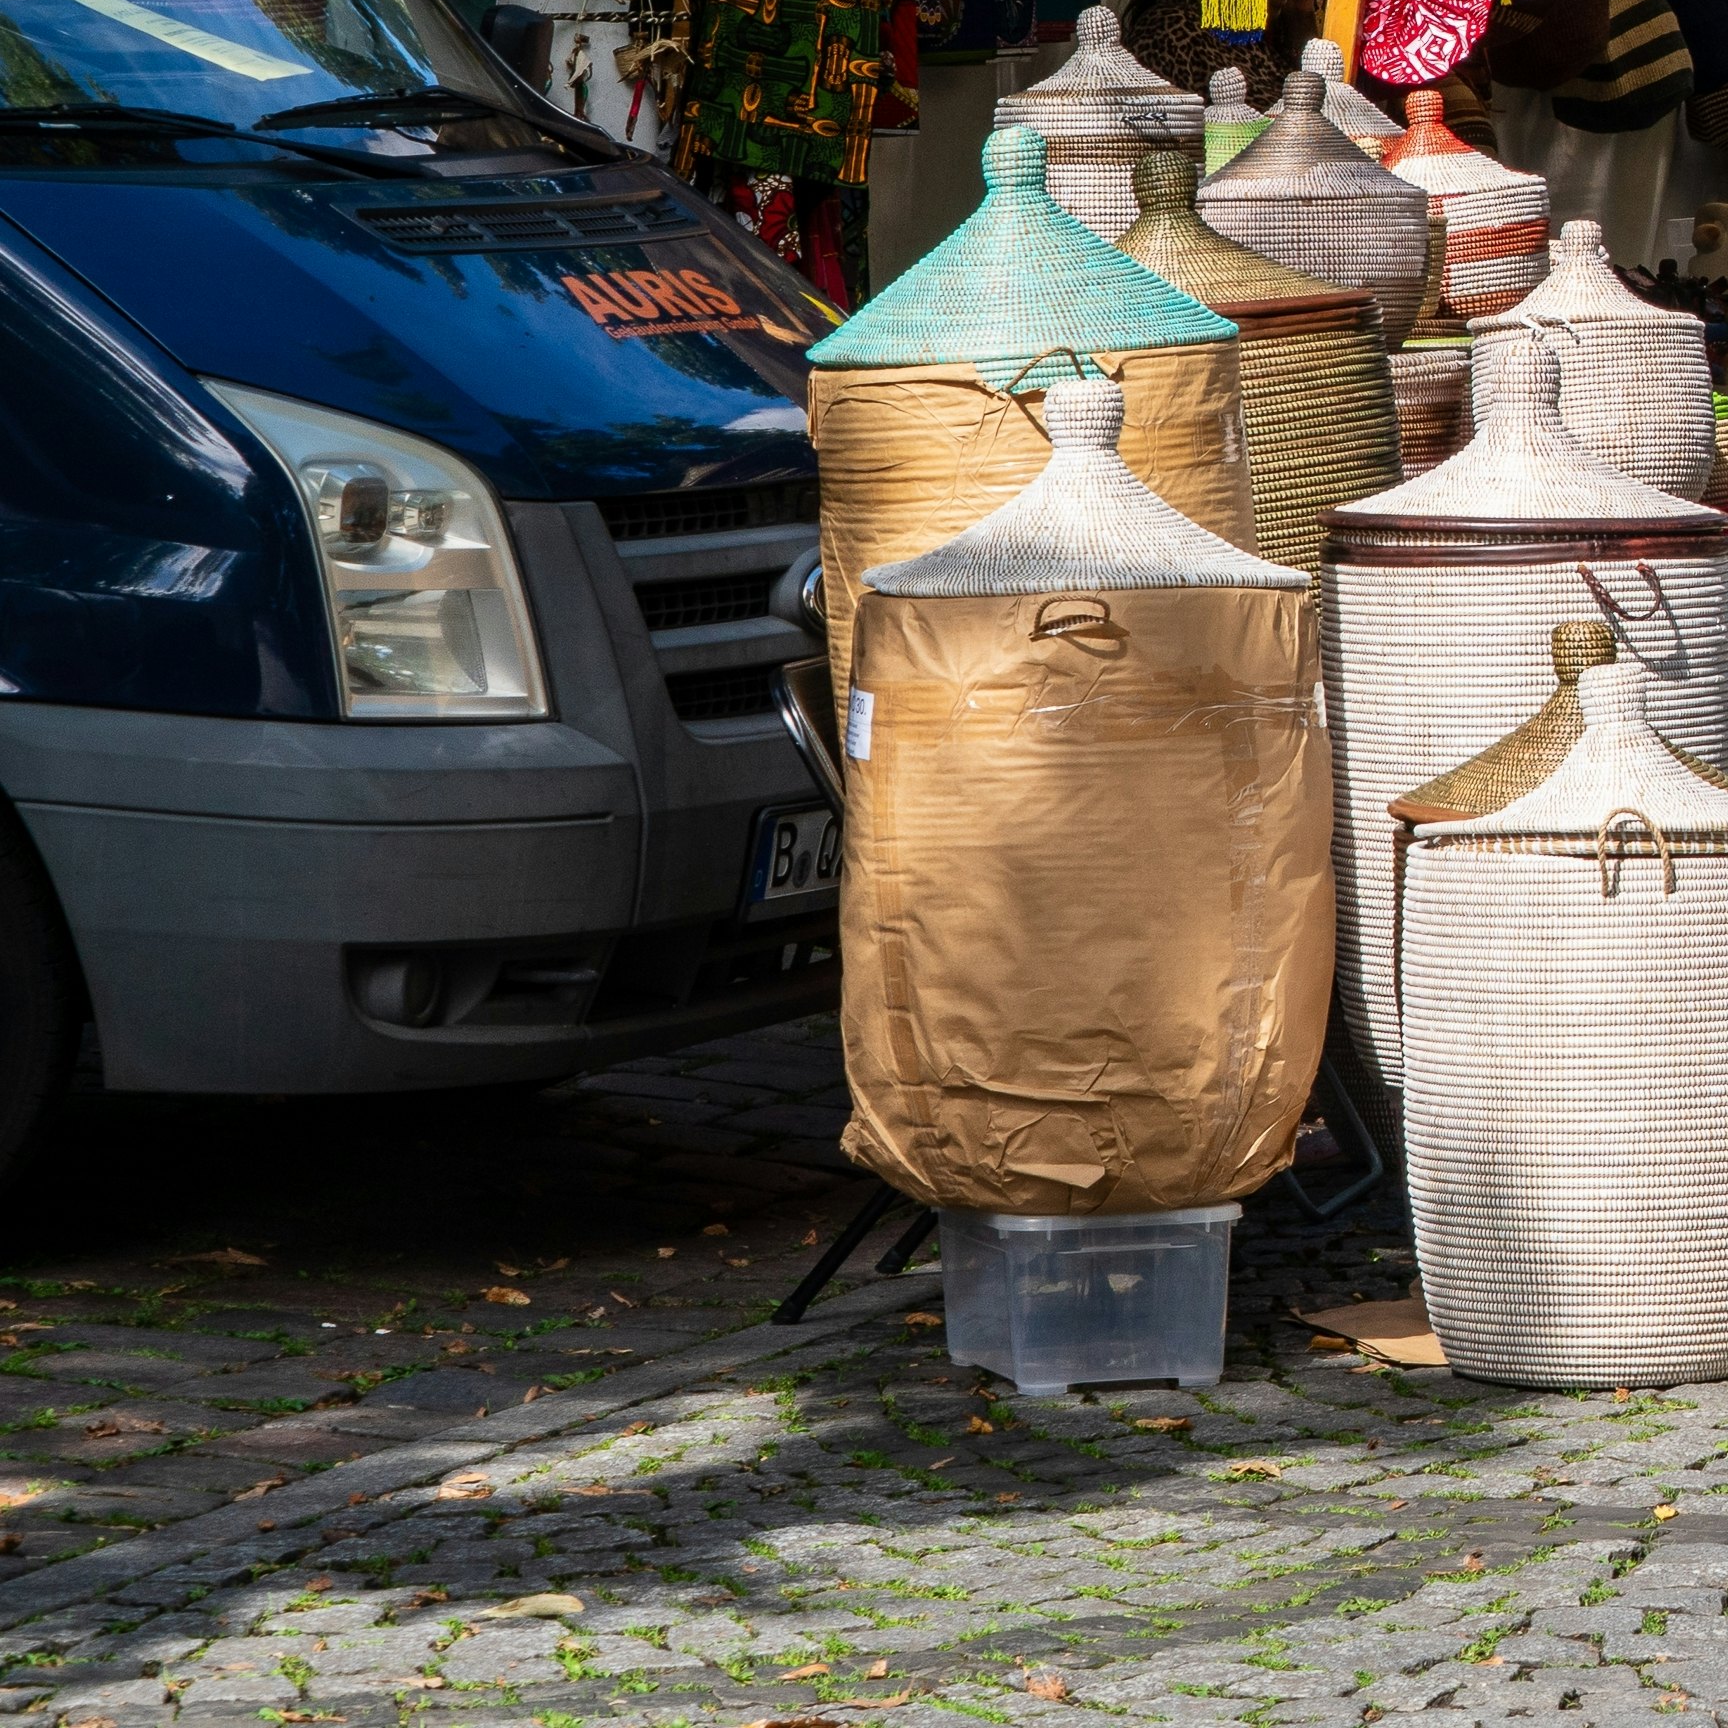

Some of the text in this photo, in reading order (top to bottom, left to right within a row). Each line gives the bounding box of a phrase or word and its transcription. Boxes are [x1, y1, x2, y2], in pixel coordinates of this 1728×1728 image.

[561, 269, 741, 324] AURIS
[605, 316, 760, 339] Gebäudereinigung GmbH
[771, 817, 842, 888] B Q
